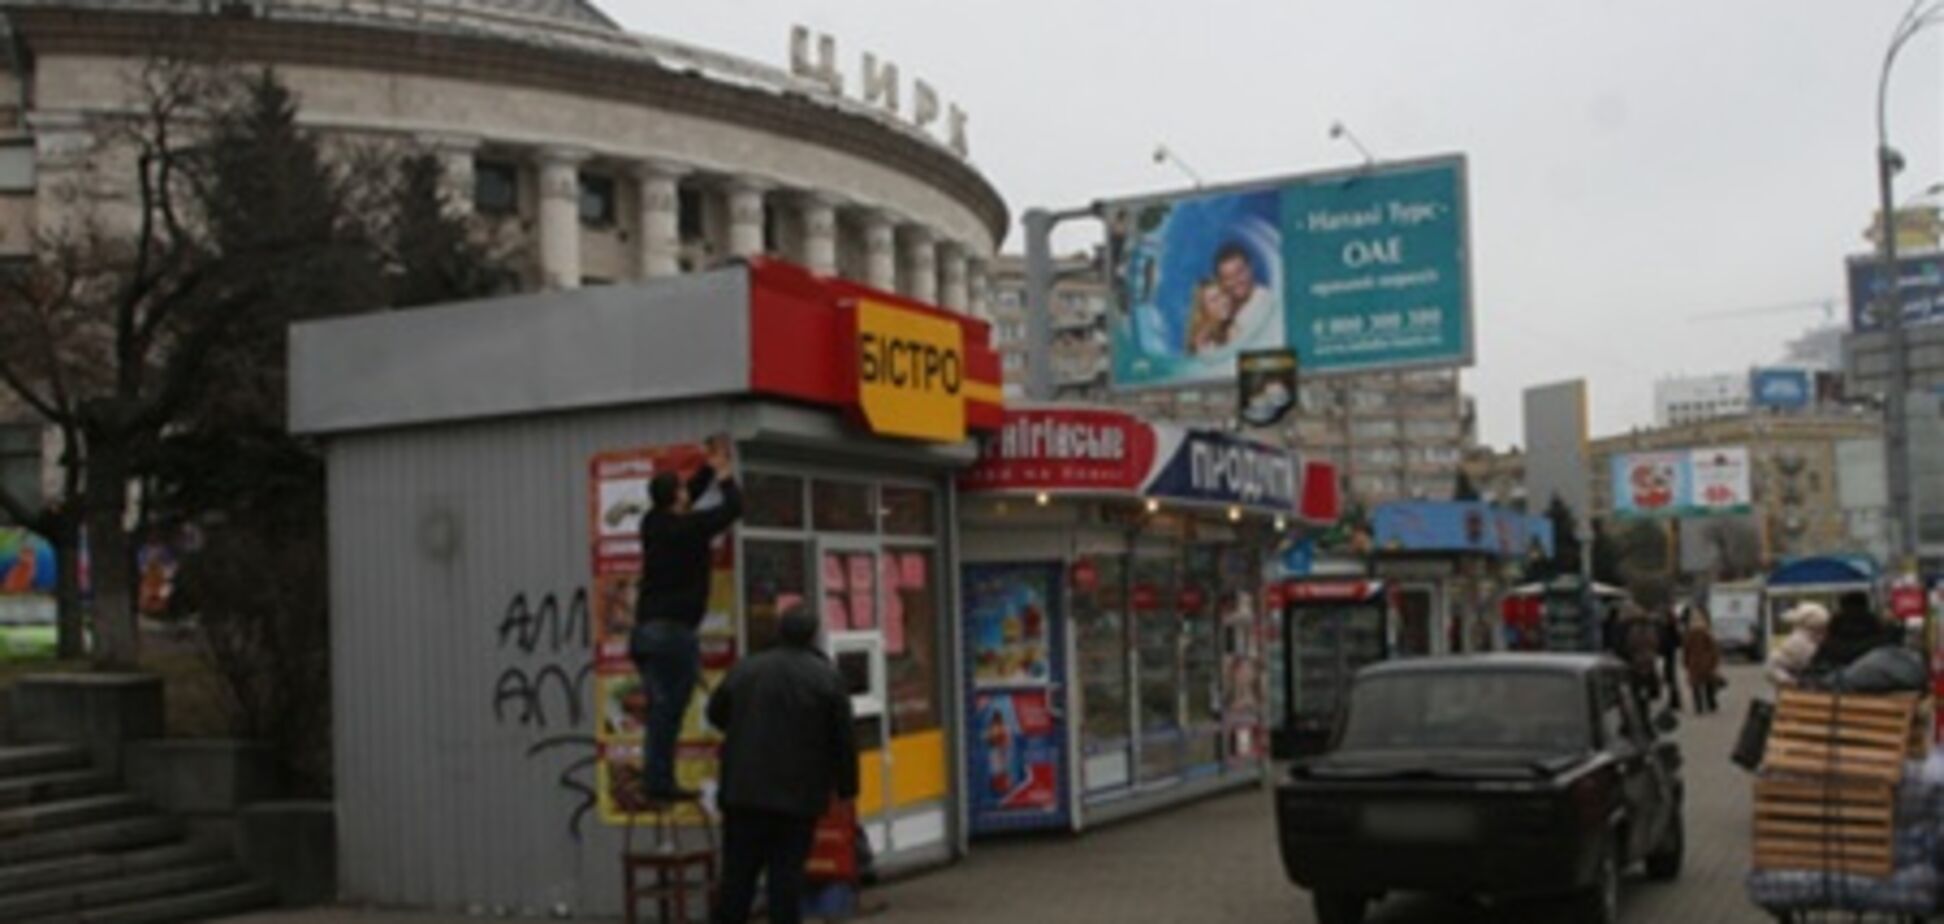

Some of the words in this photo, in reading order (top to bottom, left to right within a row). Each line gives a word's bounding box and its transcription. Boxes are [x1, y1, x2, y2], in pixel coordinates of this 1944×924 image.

[791, 25, 968, 159] ЦИРК
[1388, 200, 1436, 227] Турс
[1341, 235, 1403, 269] ОАЕ
[861, 332, 962, 397] БІСТРО
